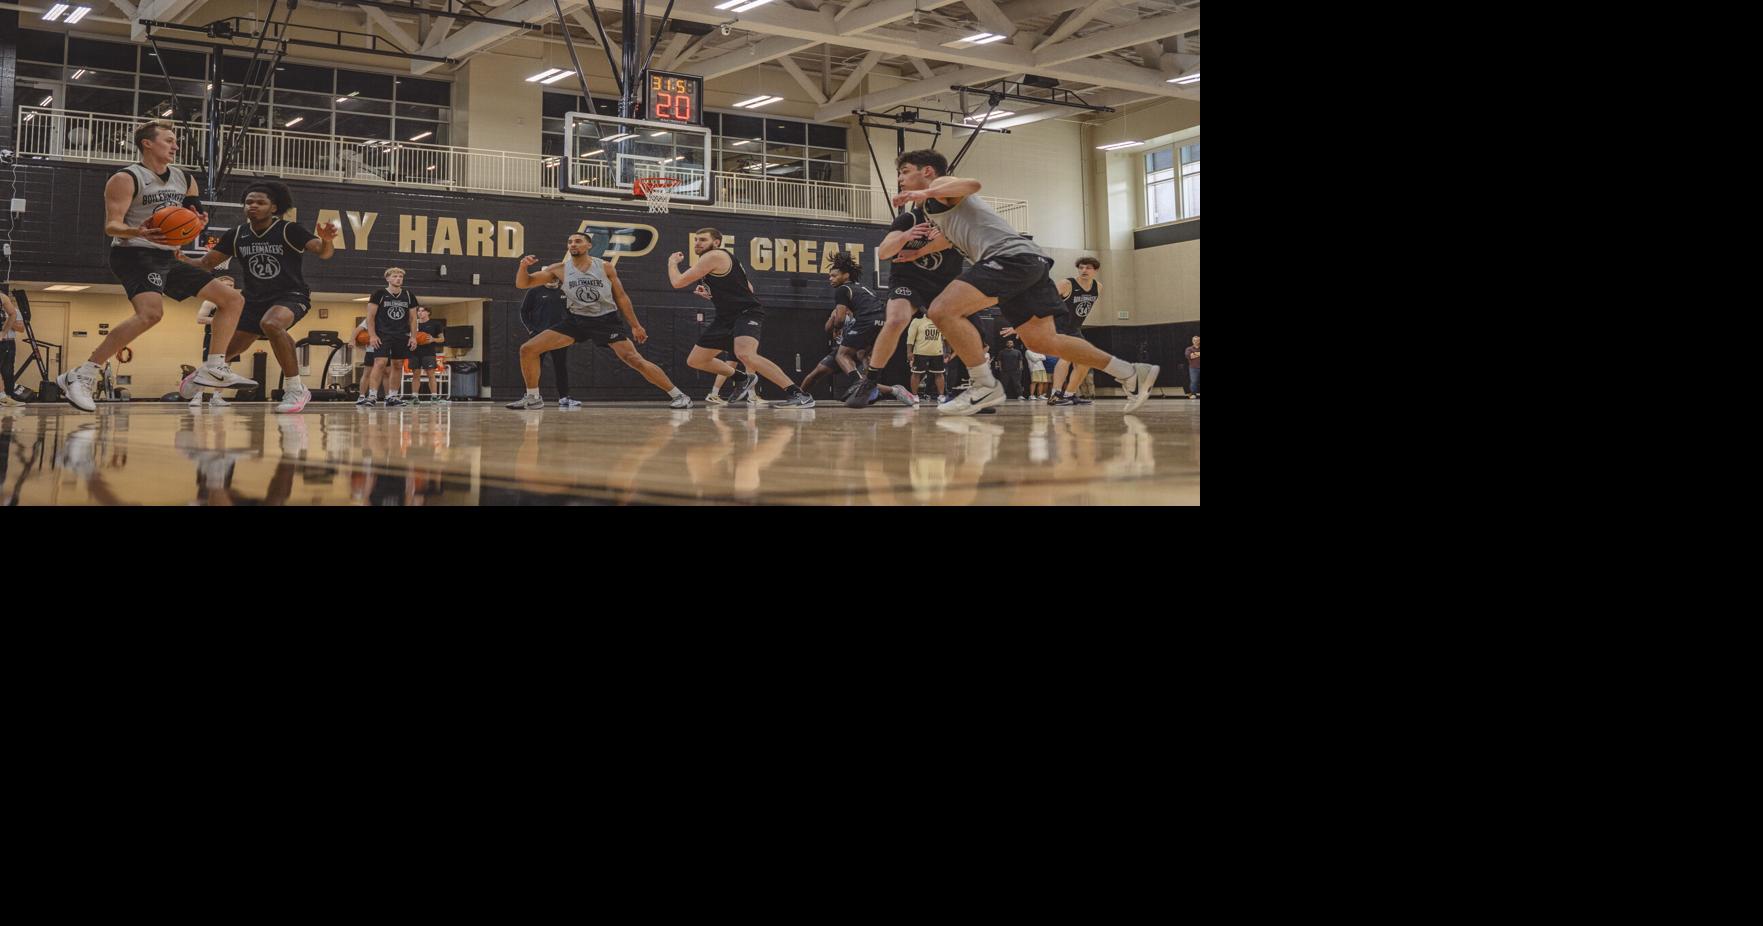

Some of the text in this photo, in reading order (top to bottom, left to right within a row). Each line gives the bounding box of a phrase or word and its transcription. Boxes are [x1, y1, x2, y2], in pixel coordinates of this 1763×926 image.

[656, 92, 690, 120] 20
[399, 214, 524, 258] HARD
[257, 263, 273, 276] 24
